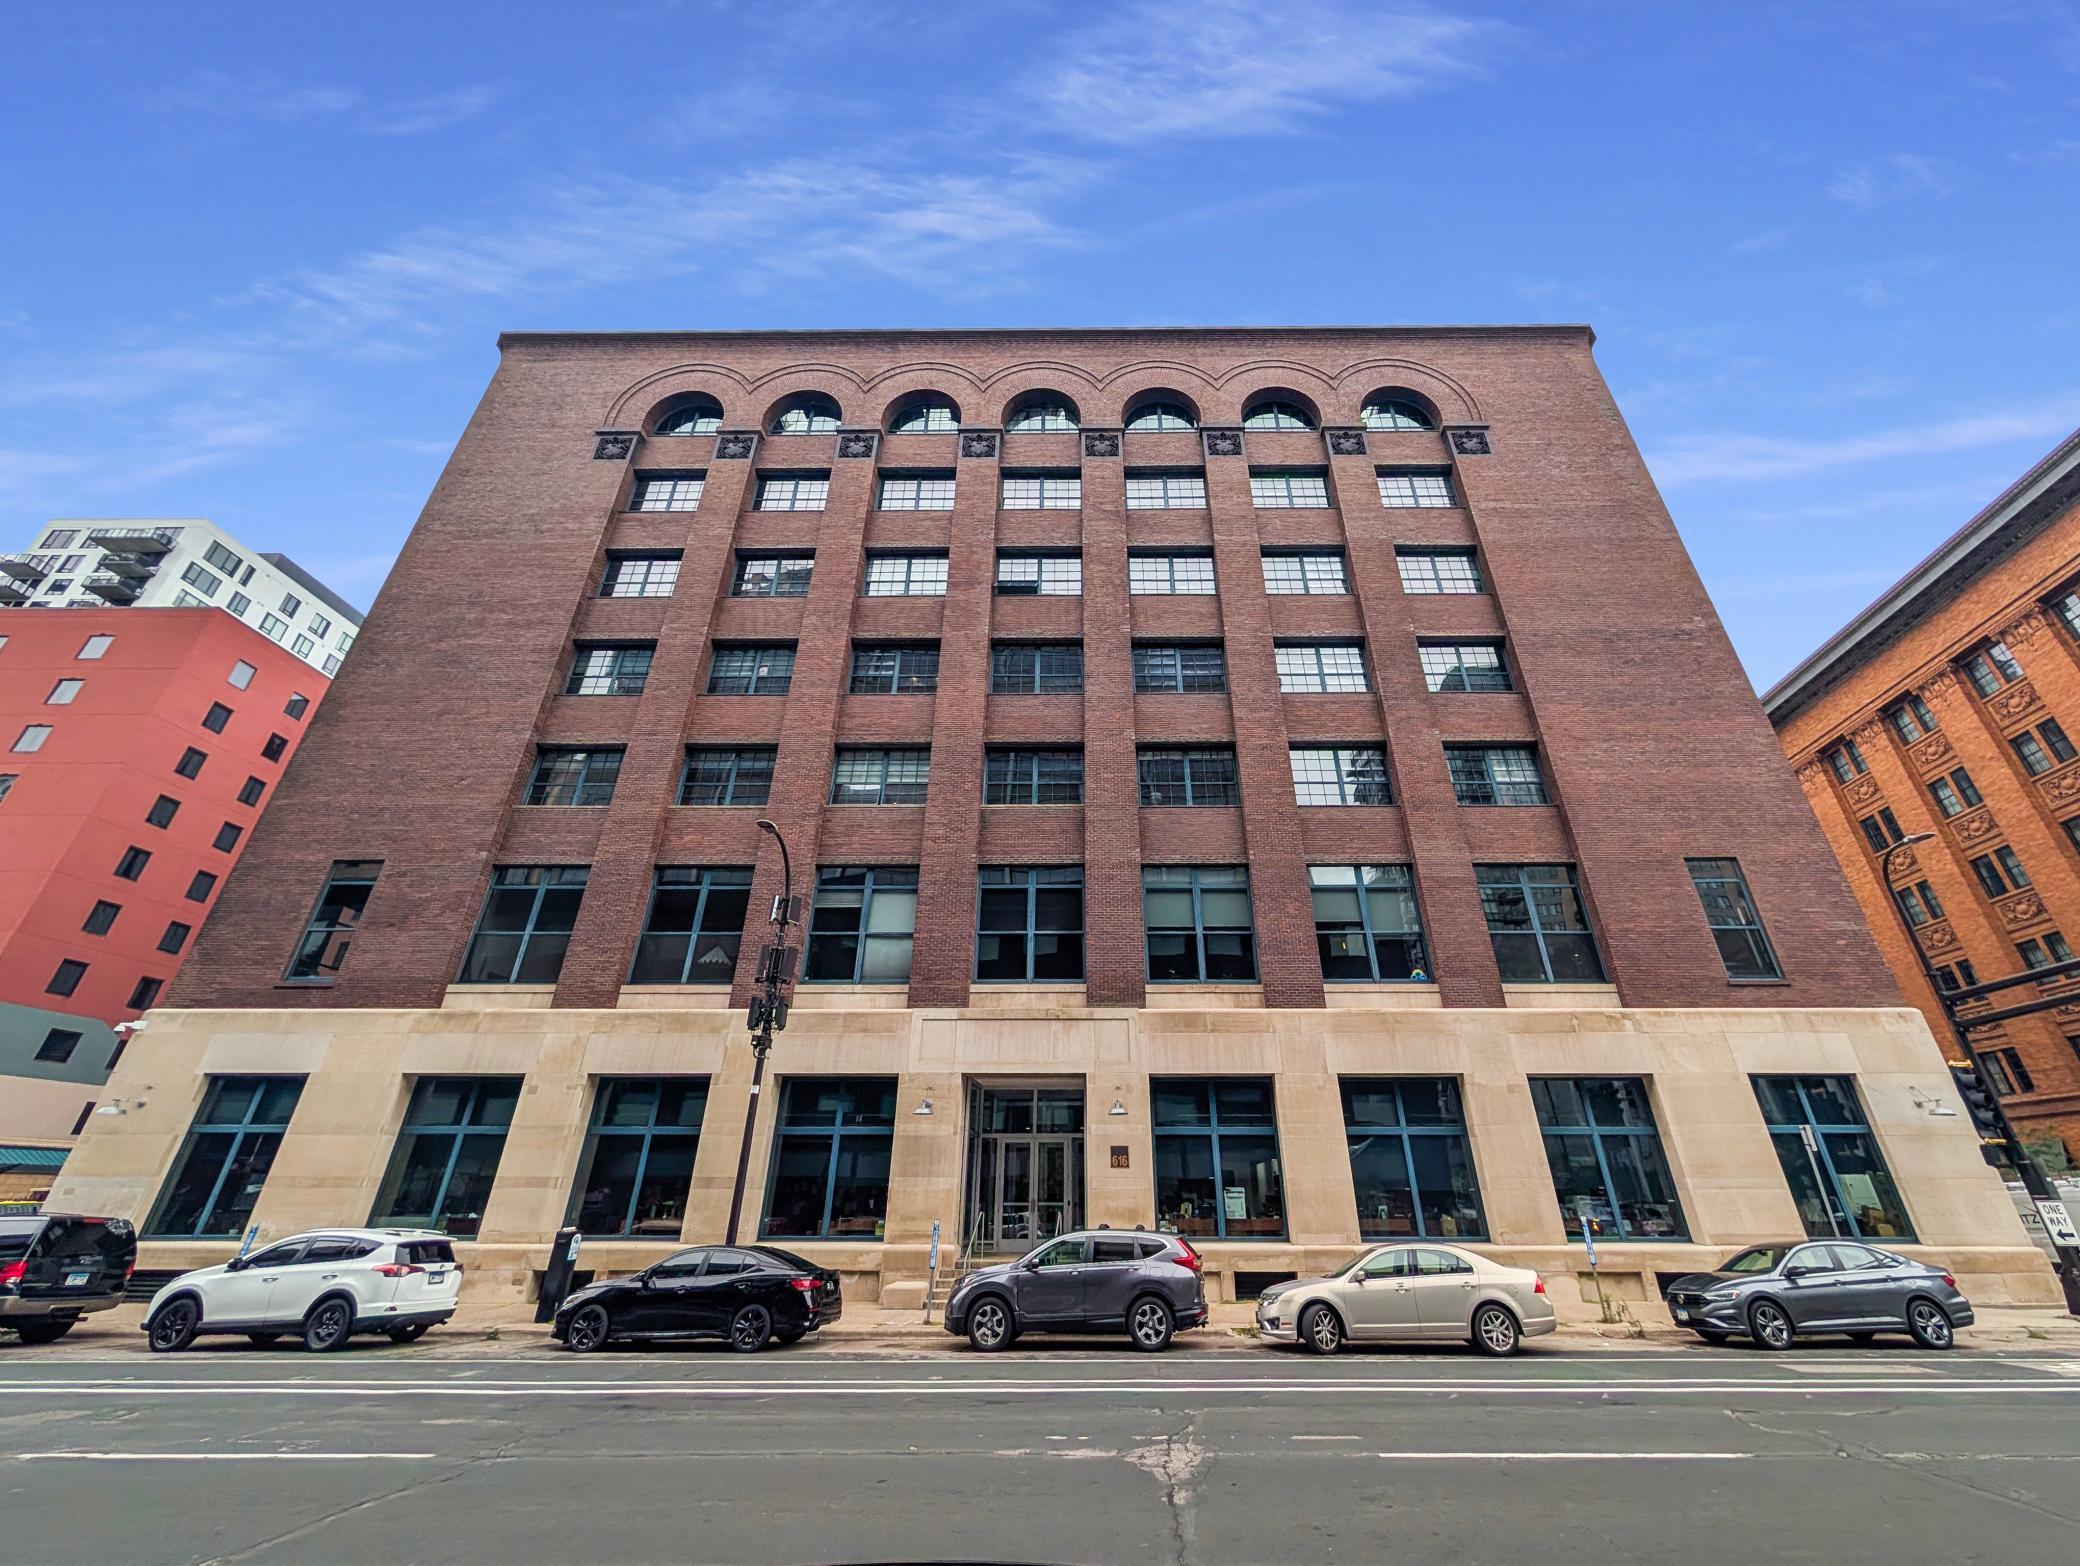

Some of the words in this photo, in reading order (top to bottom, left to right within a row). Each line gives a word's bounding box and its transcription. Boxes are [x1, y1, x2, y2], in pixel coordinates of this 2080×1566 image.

[1112, 1155, 1128, 1166] 616
[2042, 1204, 2064, 1215] ONE
[2047, 1216, 2069, 1227] WAY
